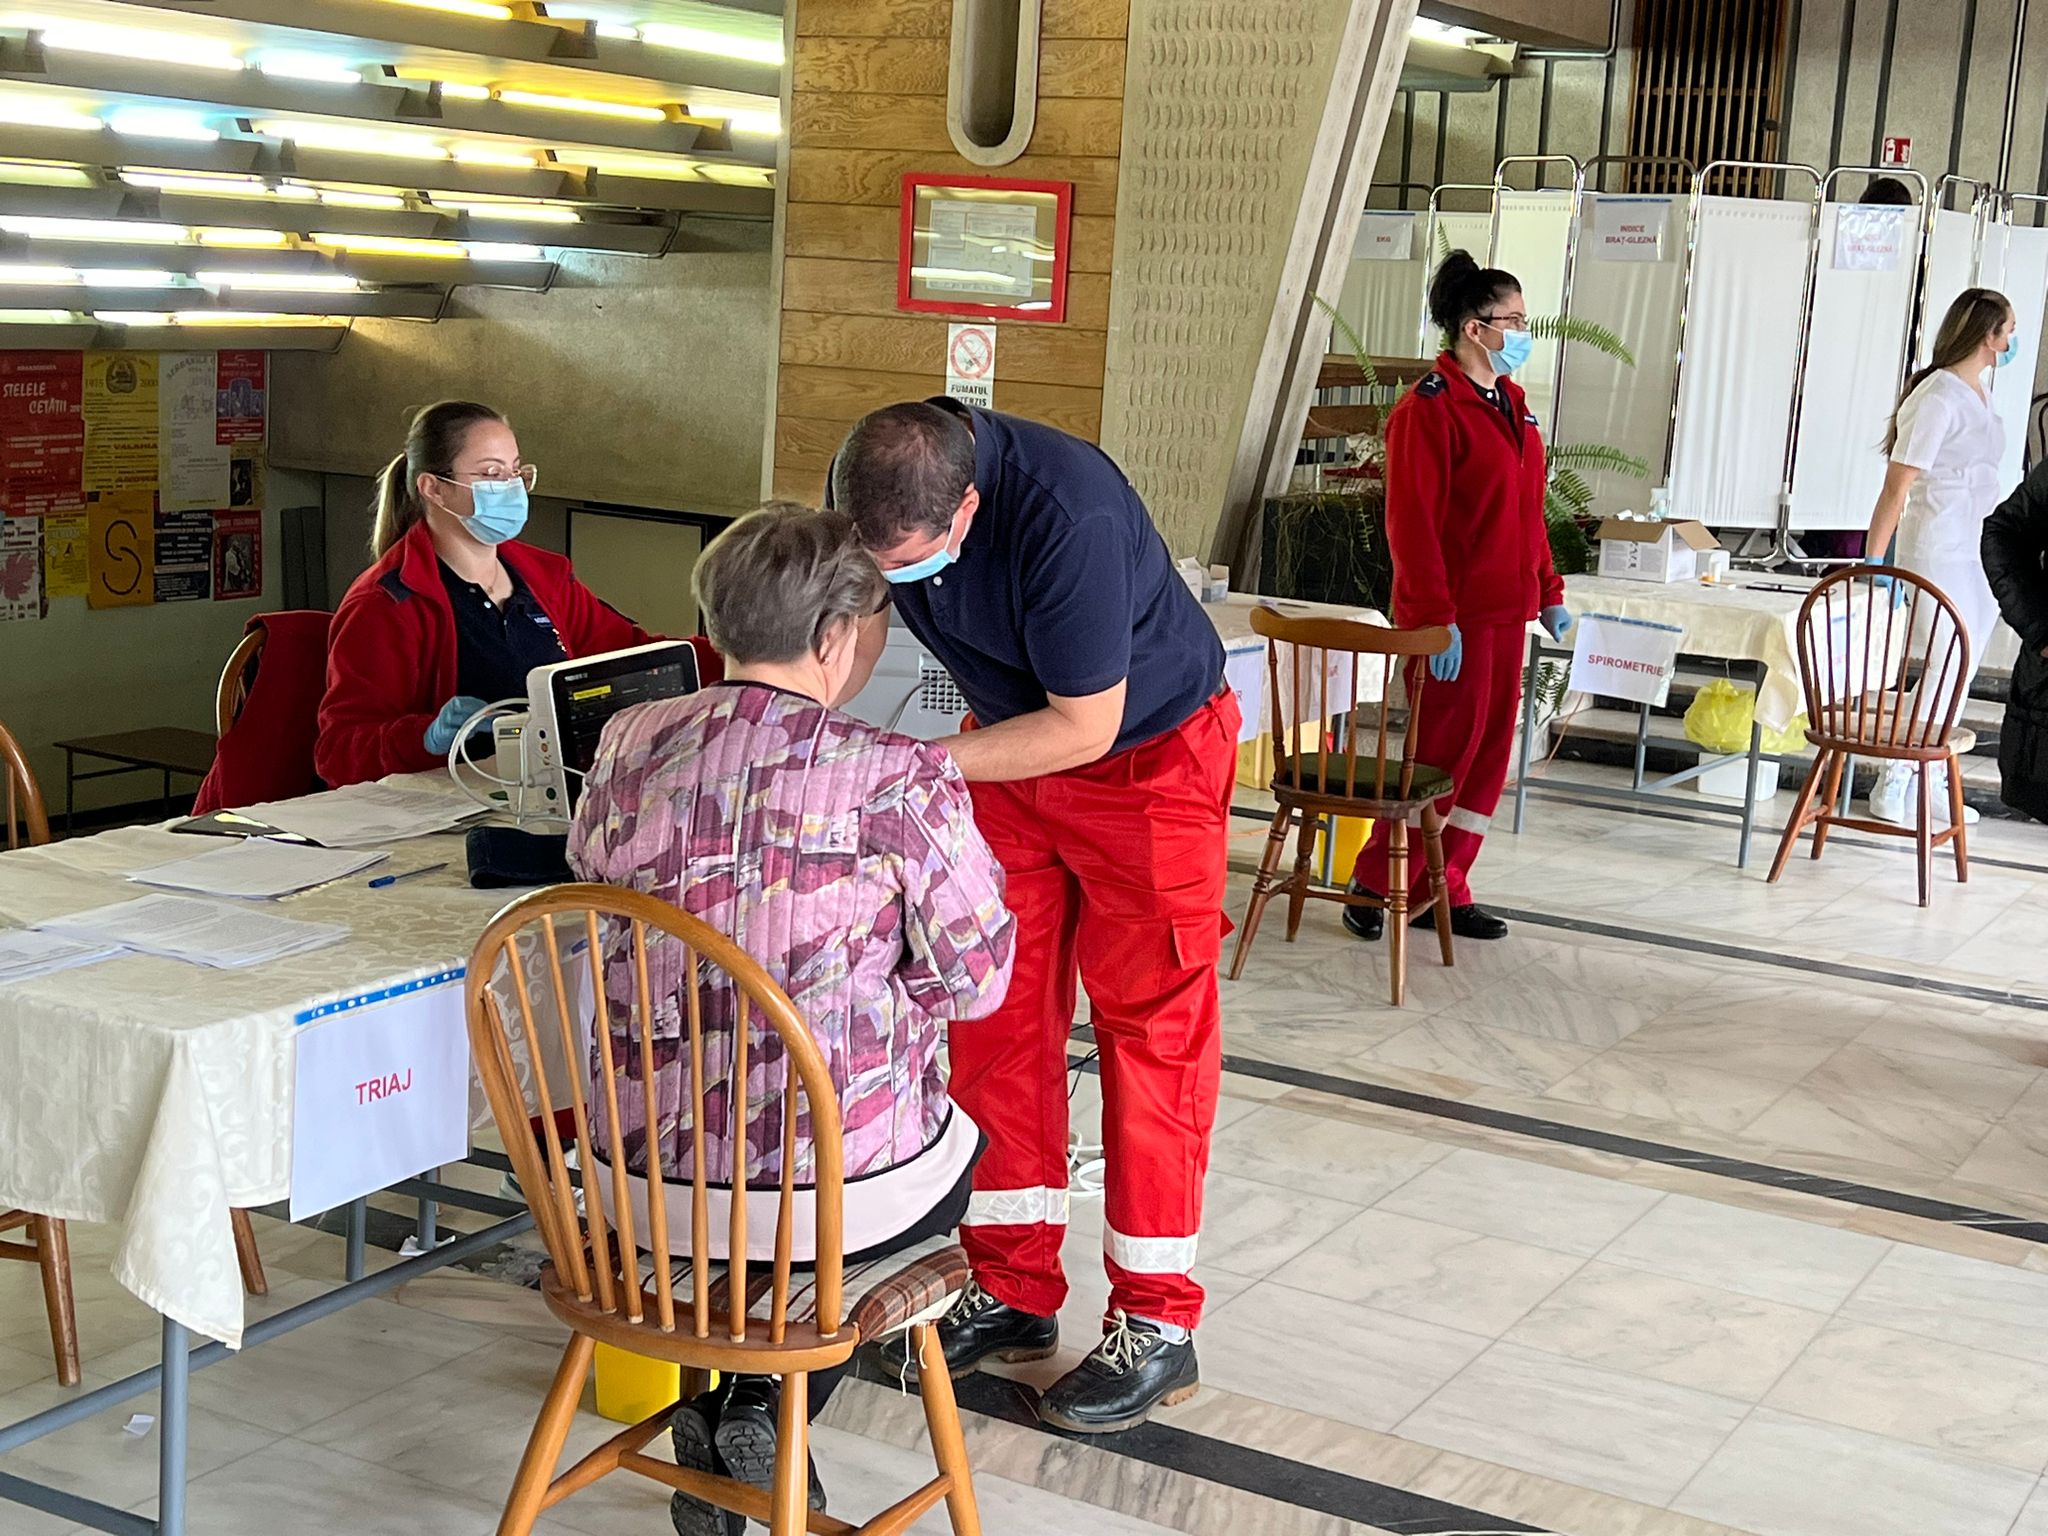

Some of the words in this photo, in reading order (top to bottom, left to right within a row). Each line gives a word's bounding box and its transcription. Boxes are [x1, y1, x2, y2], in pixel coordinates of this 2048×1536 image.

[1620, 225, 1645, 233] INDICE
[3, 382, 46, 398] STELELE
[951, 384, 988, 395] FUMATUL
[954, 396, 987, 407] TERZIS
[1587, 654, 1664, 677] SPIROMETRIE
[355, 1068, 412, 1105] TRIAJ
